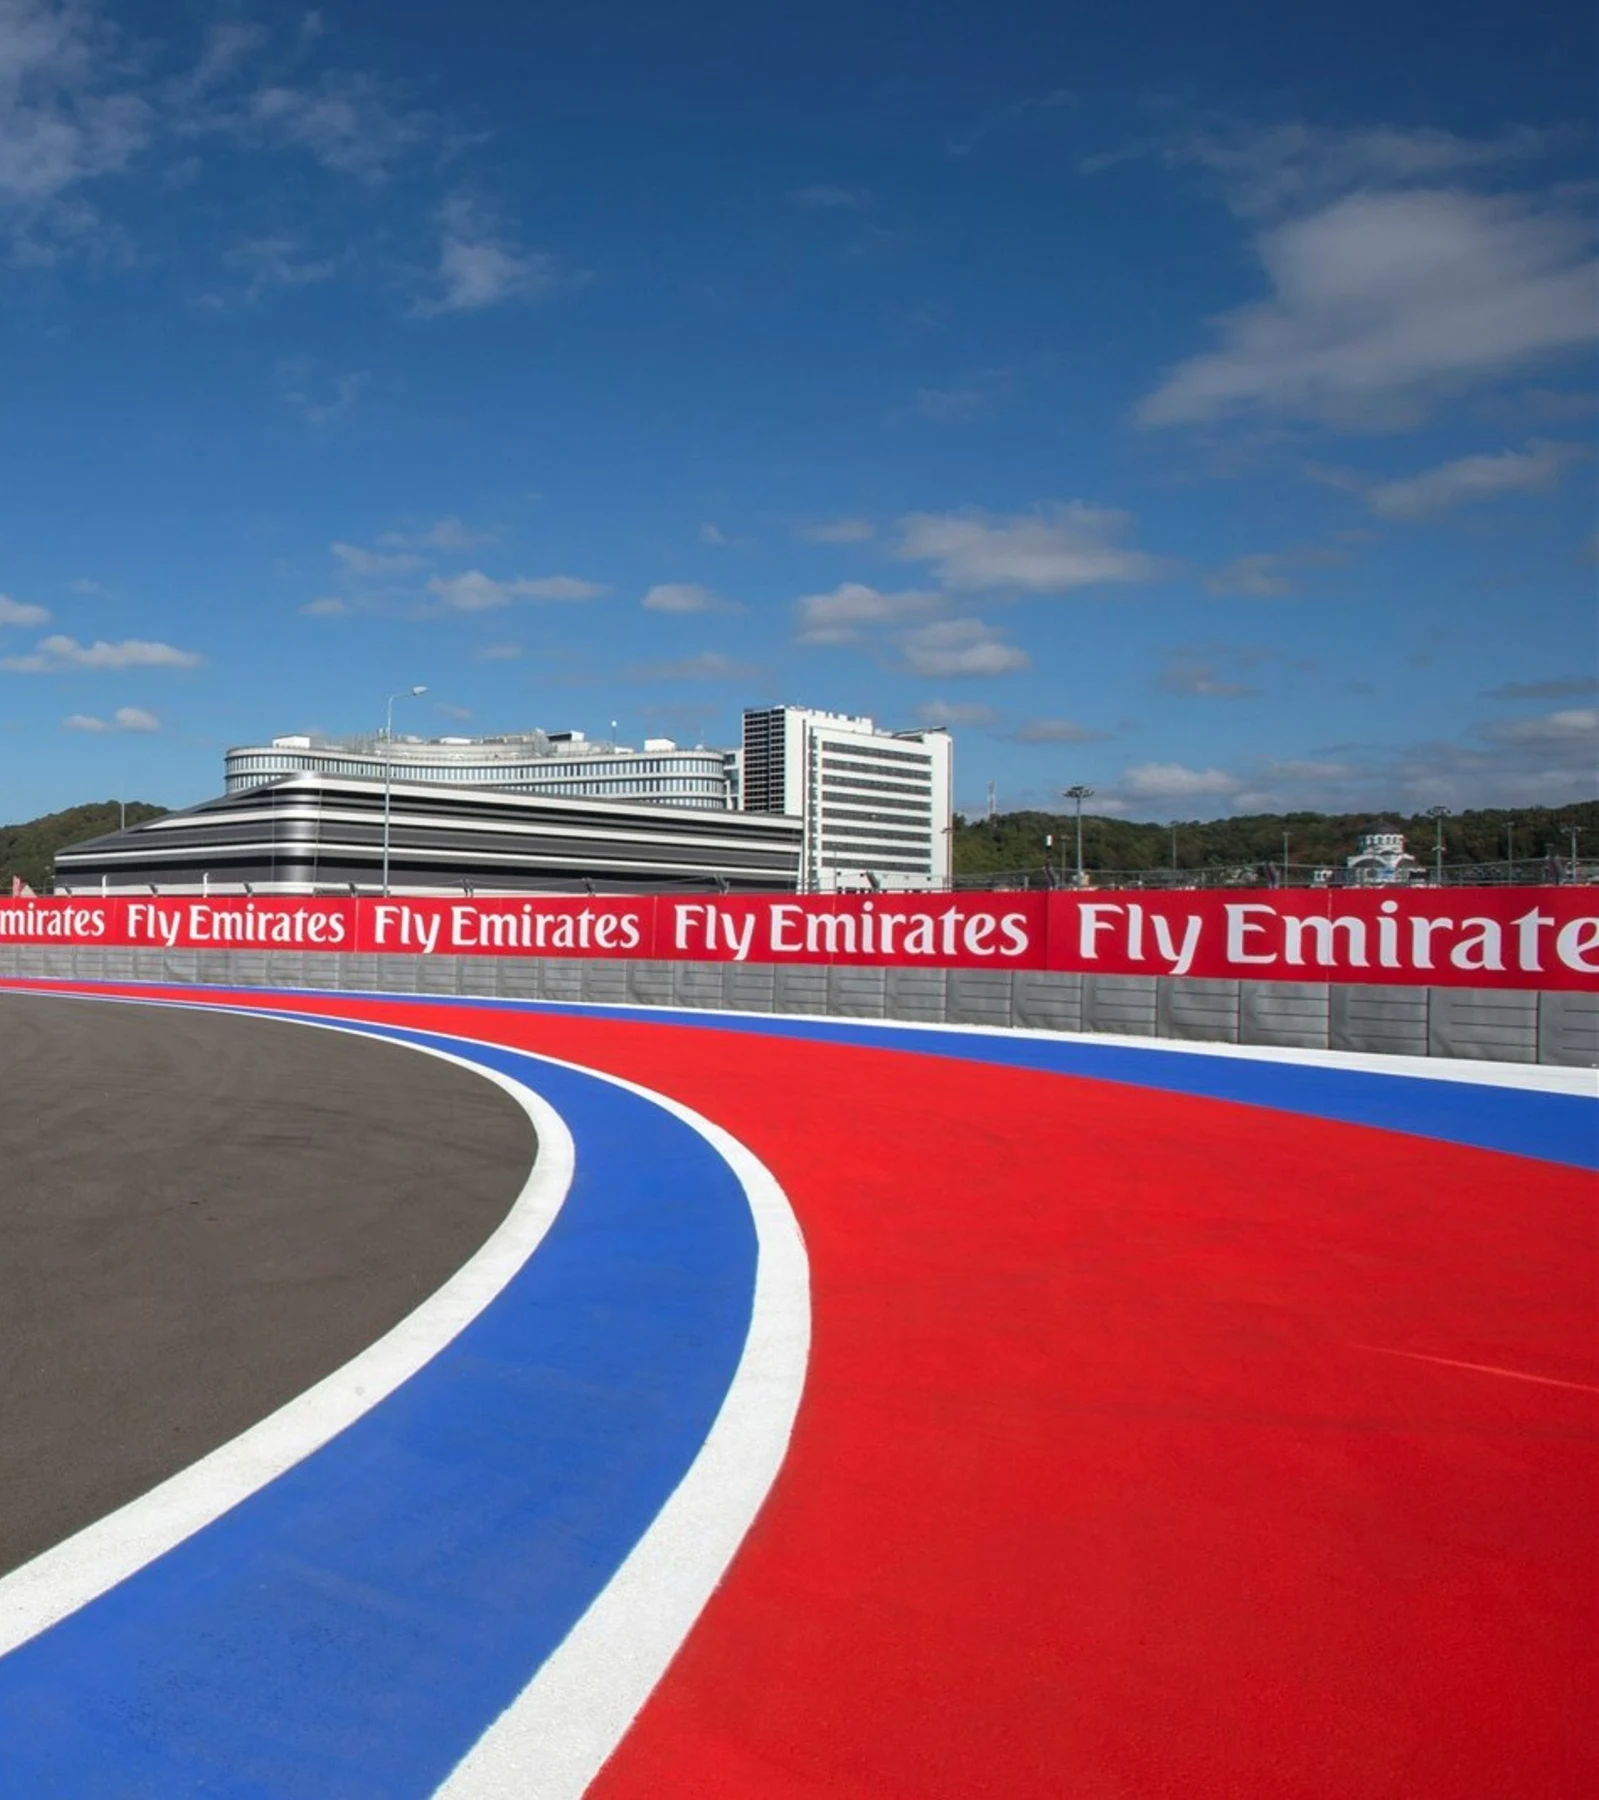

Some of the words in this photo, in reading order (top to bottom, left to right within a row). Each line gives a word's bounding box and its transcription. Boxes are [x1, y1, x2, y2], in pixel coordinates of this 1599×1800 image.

[128, 904, 180, 947] Fly
[188, 904, 345, 942] Emirates
[374, 906, 441, 954] Fly
[451, 904, 640, 949] Emirates
[675, 904, 756, 961] Fly
[770, 901, 1028, 957] Emirates
[1077, 902, 1203, 975] Fly
[1223, 899, 1599, 974] Emirate
